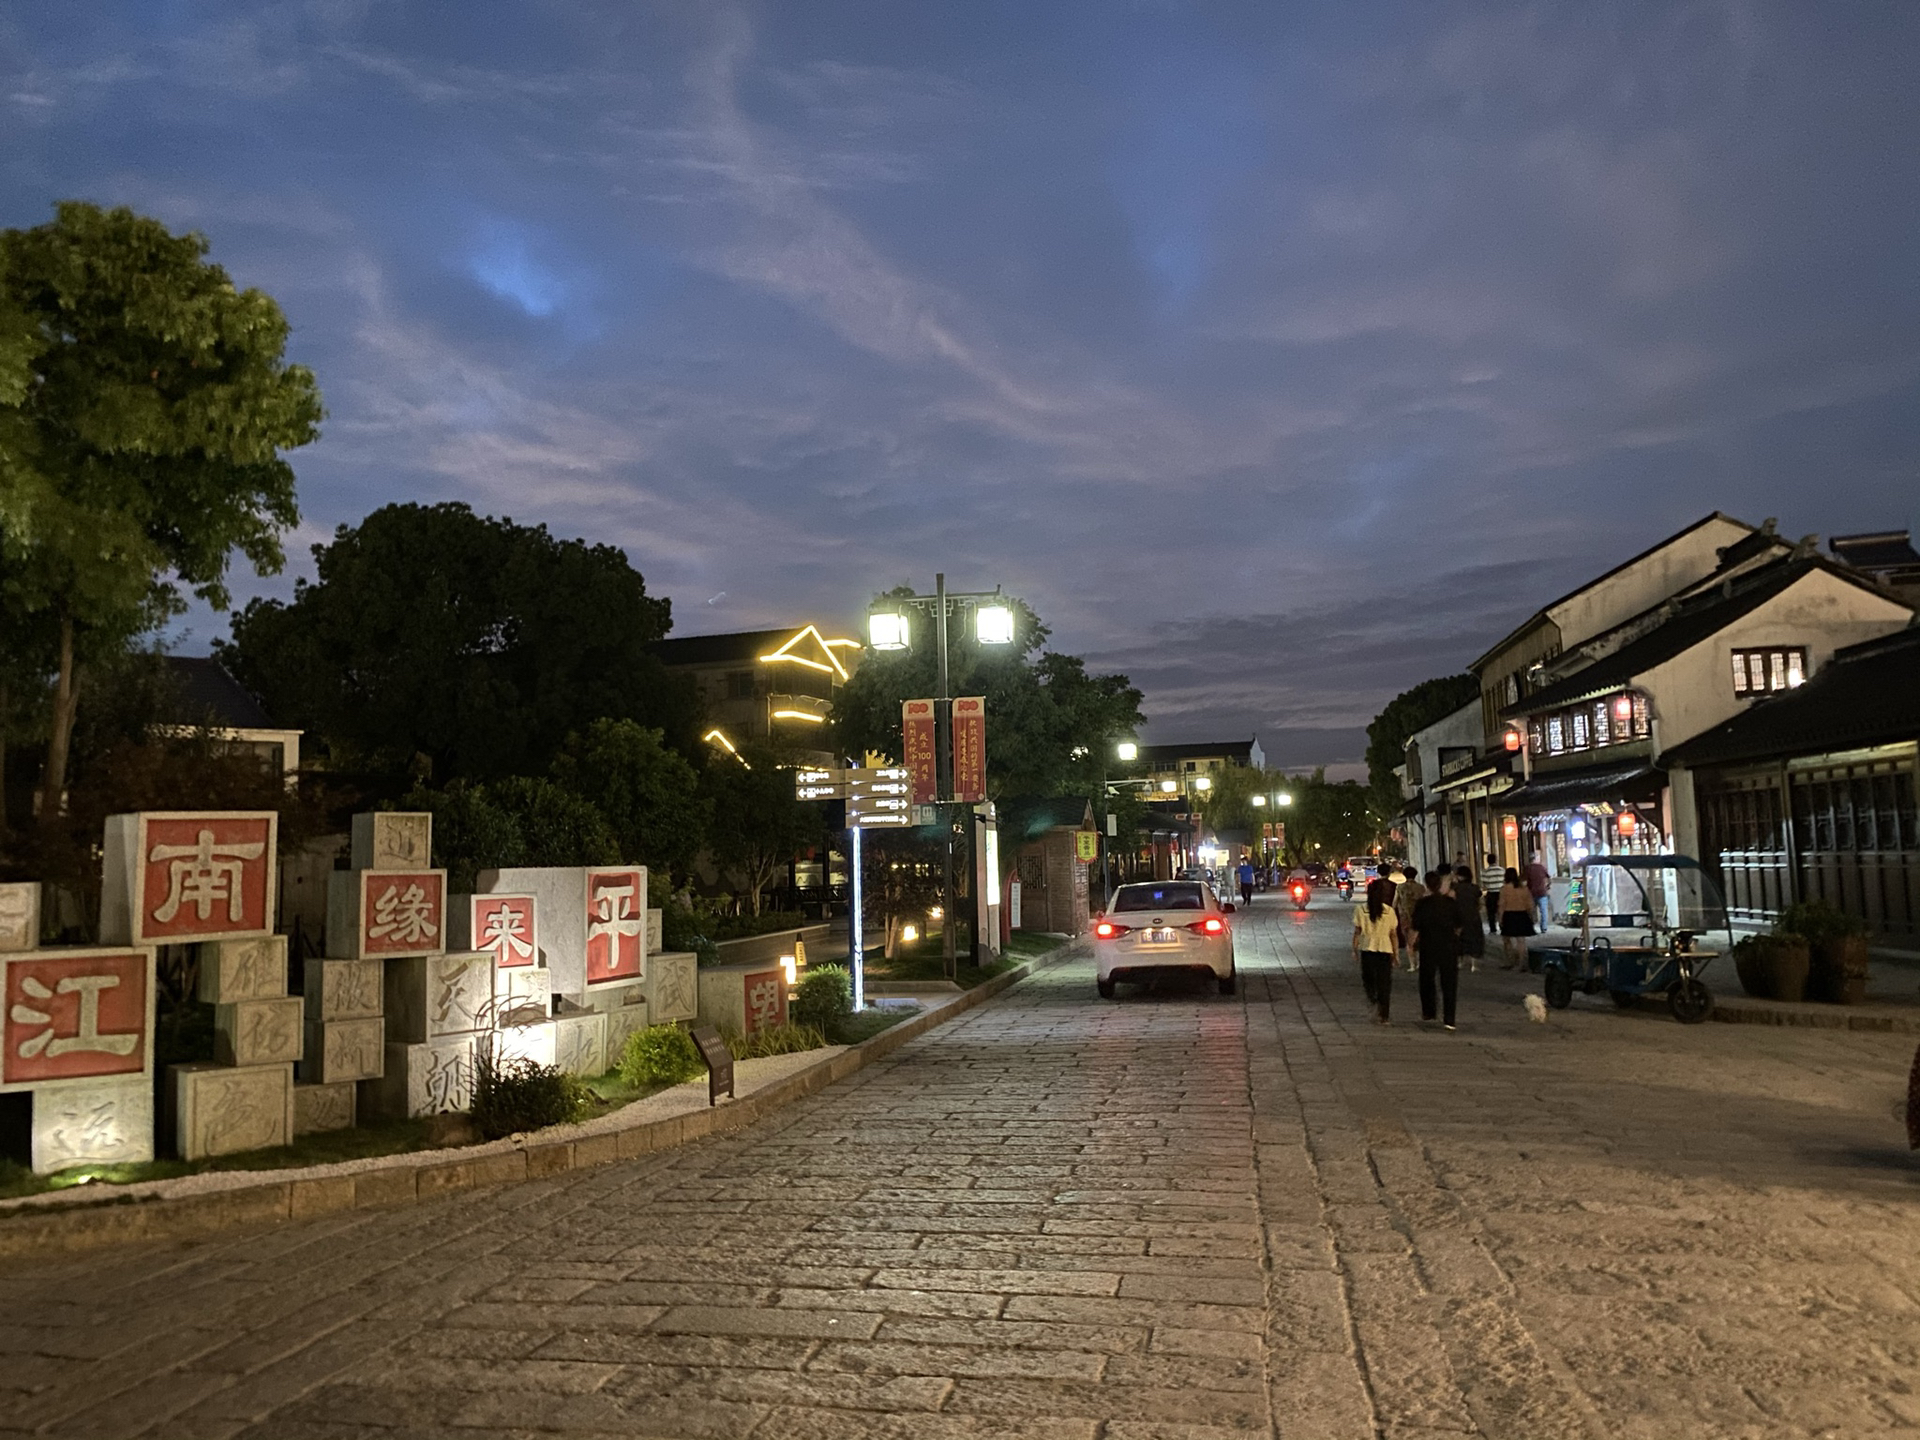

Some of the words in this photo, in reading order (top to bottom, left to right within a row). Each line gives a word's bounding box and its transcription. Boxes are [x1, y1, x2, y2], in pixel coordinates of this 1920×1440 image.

[150, 829, 264, 923] 南
[368, 883, 438, 943] 缘
[478, 902, 534, 962] 来
[588, 885, 642, 969] 平
[11, 974, 138, 1059] 江
[749, 979, 781, 1034] 望
